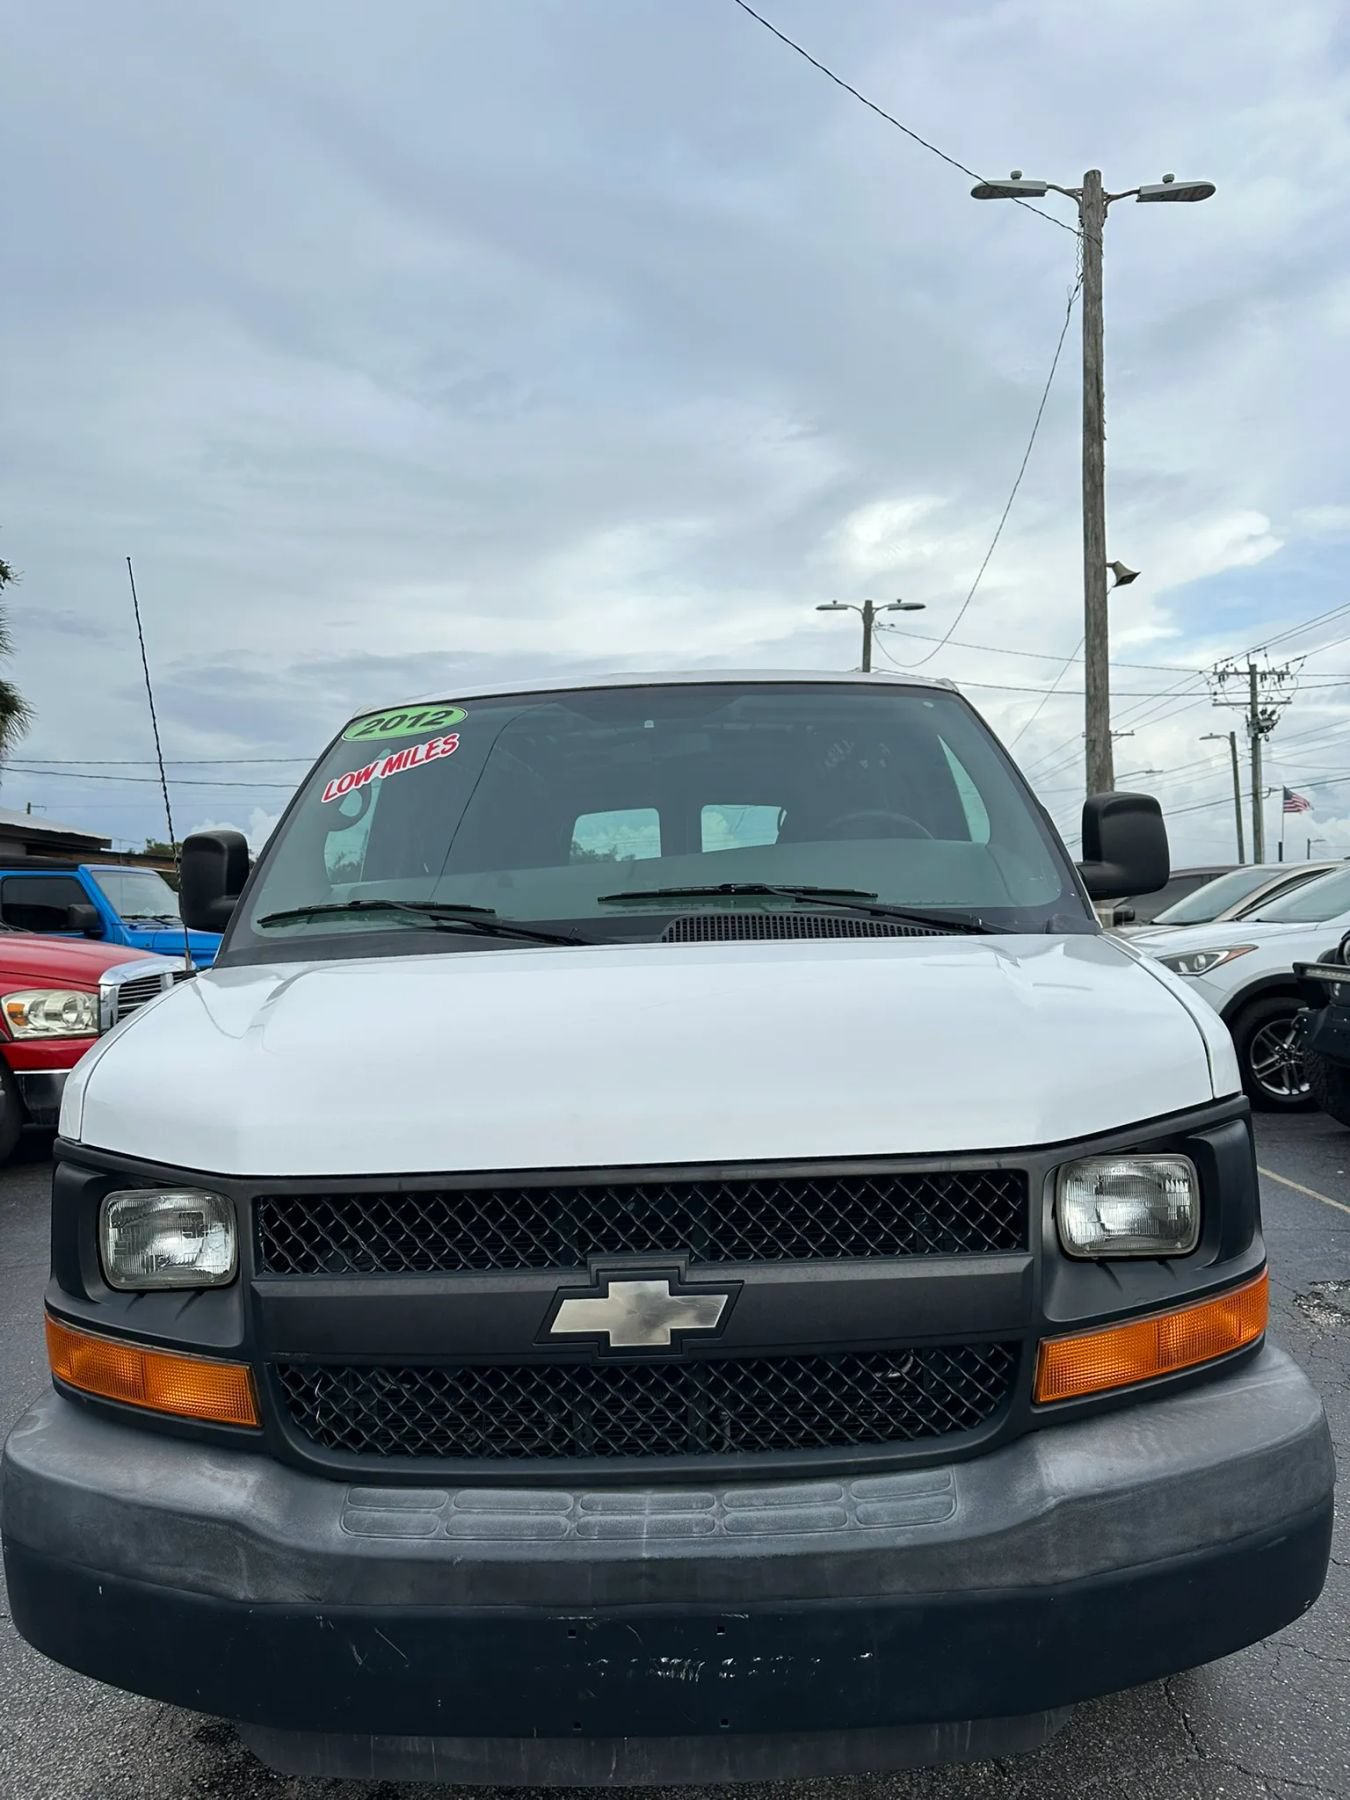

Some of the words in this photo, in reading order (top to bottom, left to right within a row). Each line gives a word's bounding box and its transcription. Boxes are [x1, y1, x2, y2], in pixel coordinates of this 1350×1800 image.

[353, 710, 454, 737] 2012
[323, 761, 379, 801] LOW
[380, 734, 458, 777] MILES
